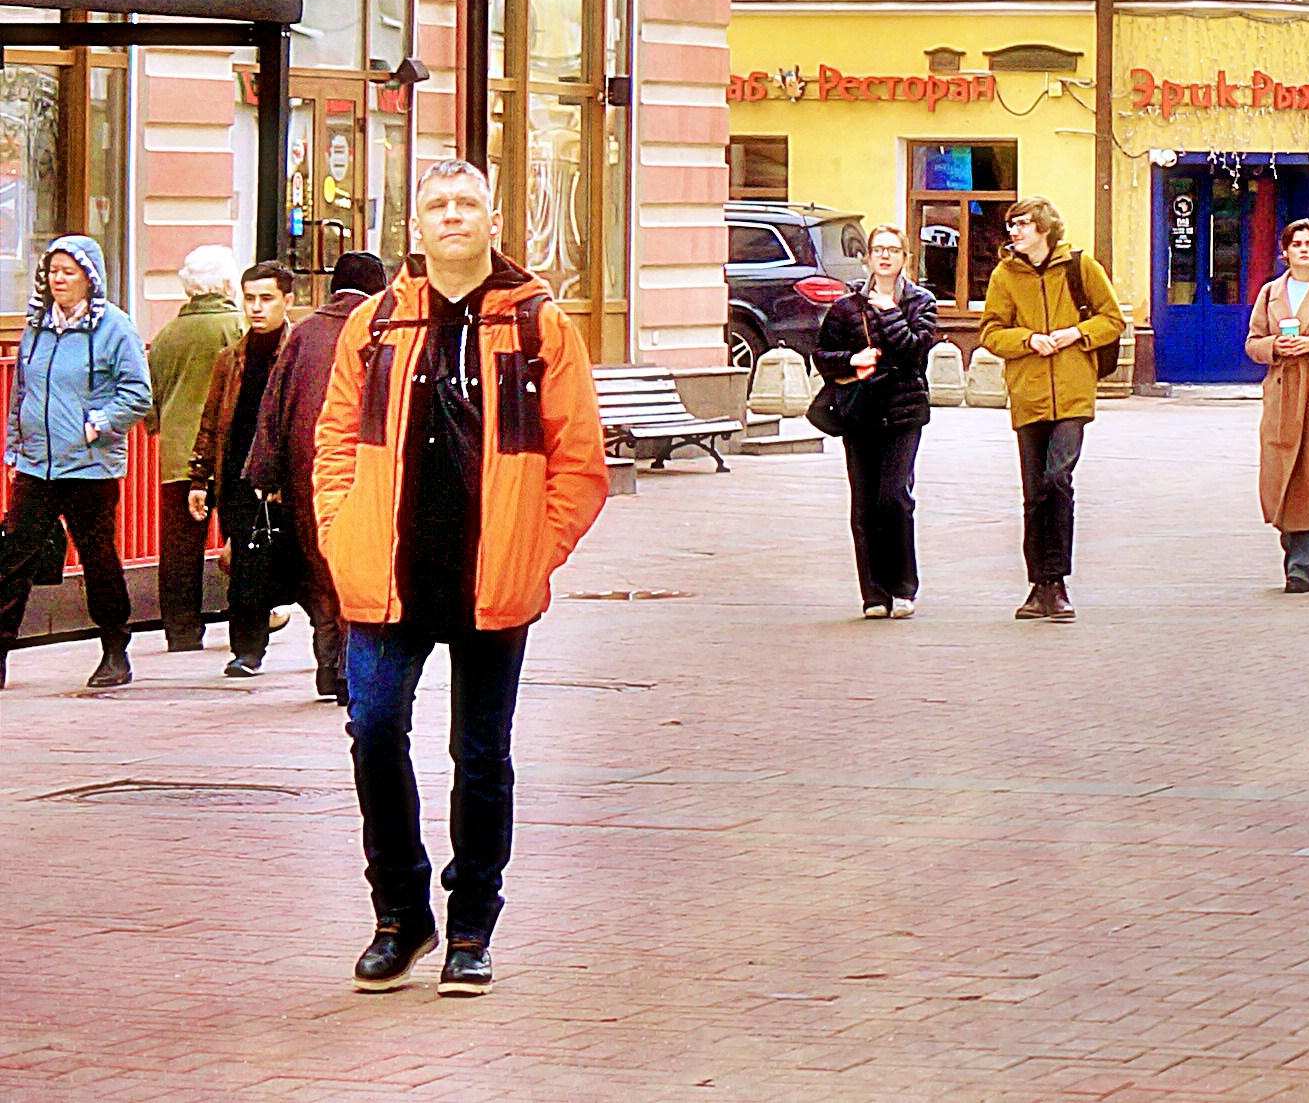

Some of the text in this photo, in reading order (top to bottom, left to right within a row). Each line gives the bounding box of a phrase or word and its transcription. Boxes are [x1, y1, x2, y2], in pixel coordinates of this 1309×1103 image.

[725, 63, 995, 113] аб Ресторан
[1130, 68, 1239, 120] Эрик
